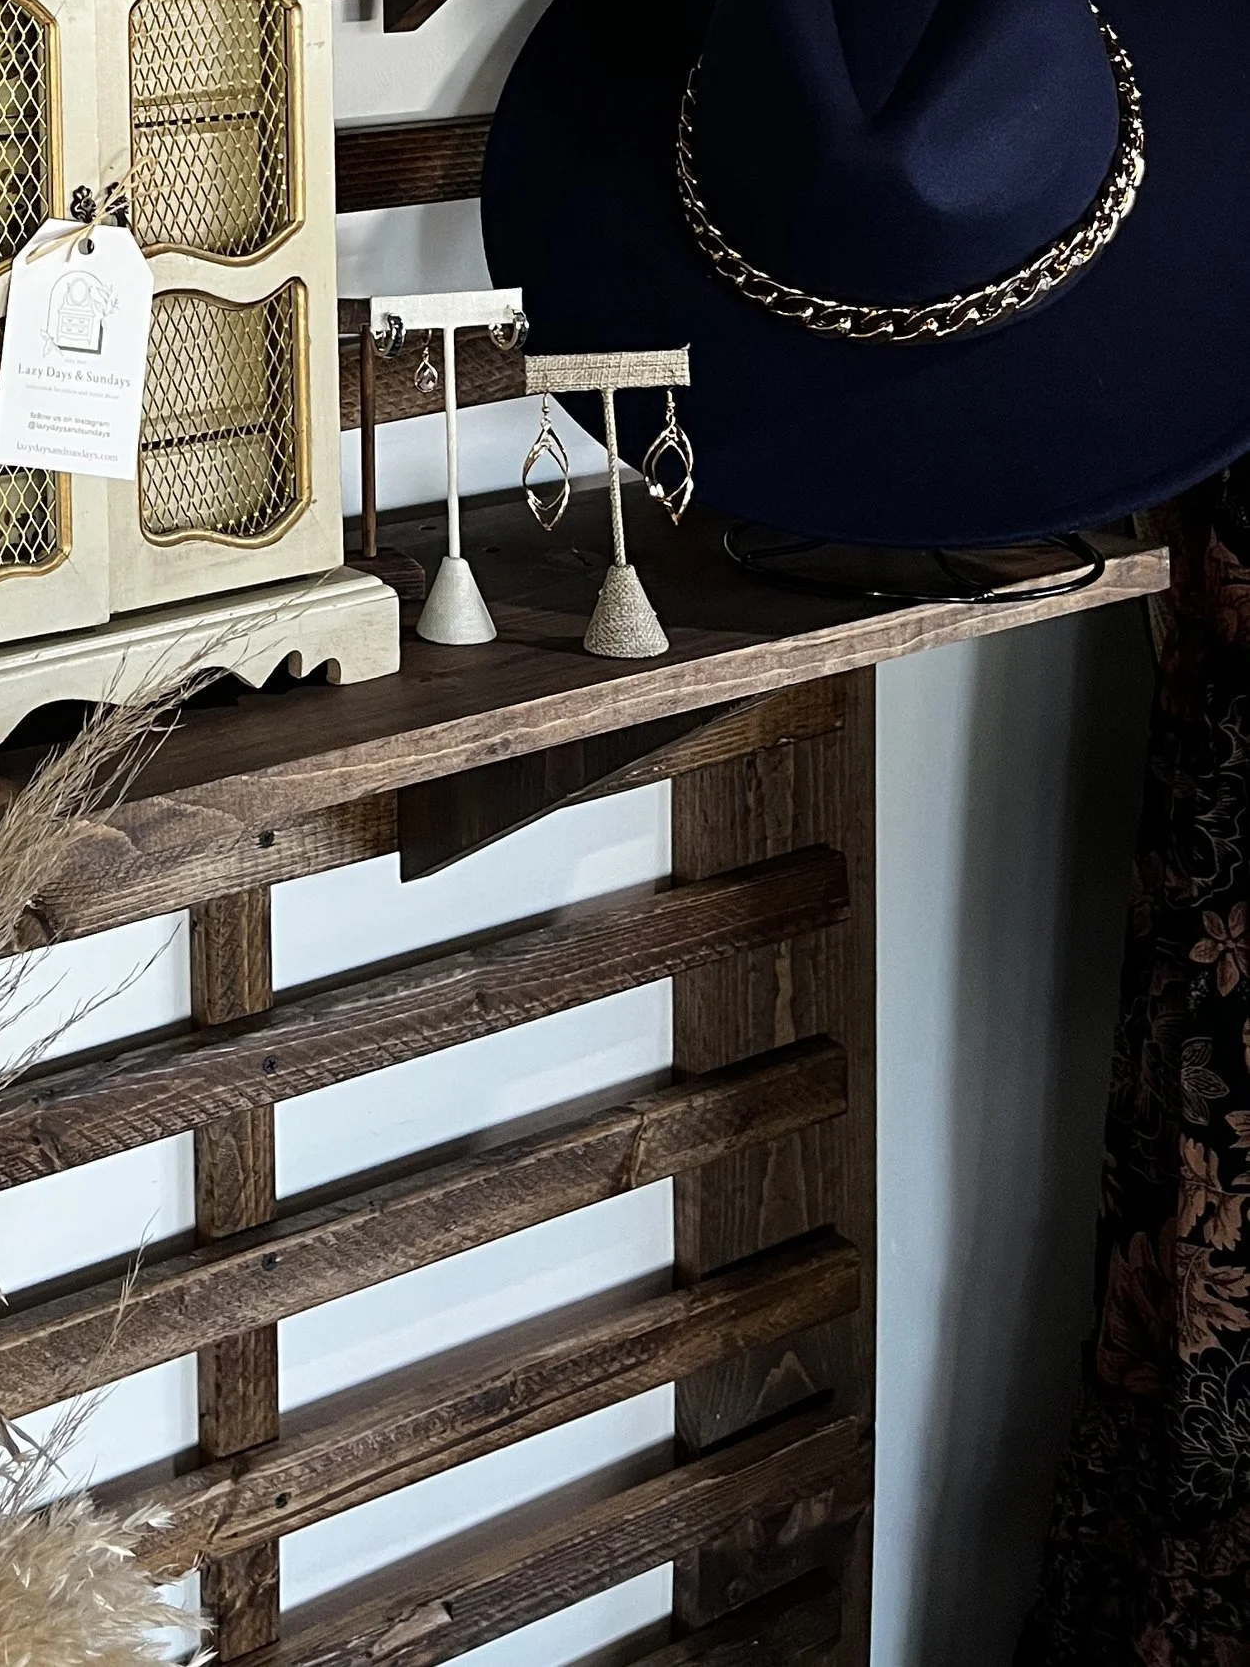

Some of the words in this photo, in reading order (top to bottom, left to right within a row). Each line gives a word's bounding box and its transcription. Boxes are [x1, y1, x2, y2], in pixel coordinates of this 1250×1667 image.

[18, 363, 44, 380] Lazy
[46, 366, 72, 383] Days
[75, 370, 83, 381] &
[86, 372, 131, 389] Sundays
[28, 421, 110, 439] @lazydaysandsundays
[16, 441, 118, 462] lazydaysandsundays.com
